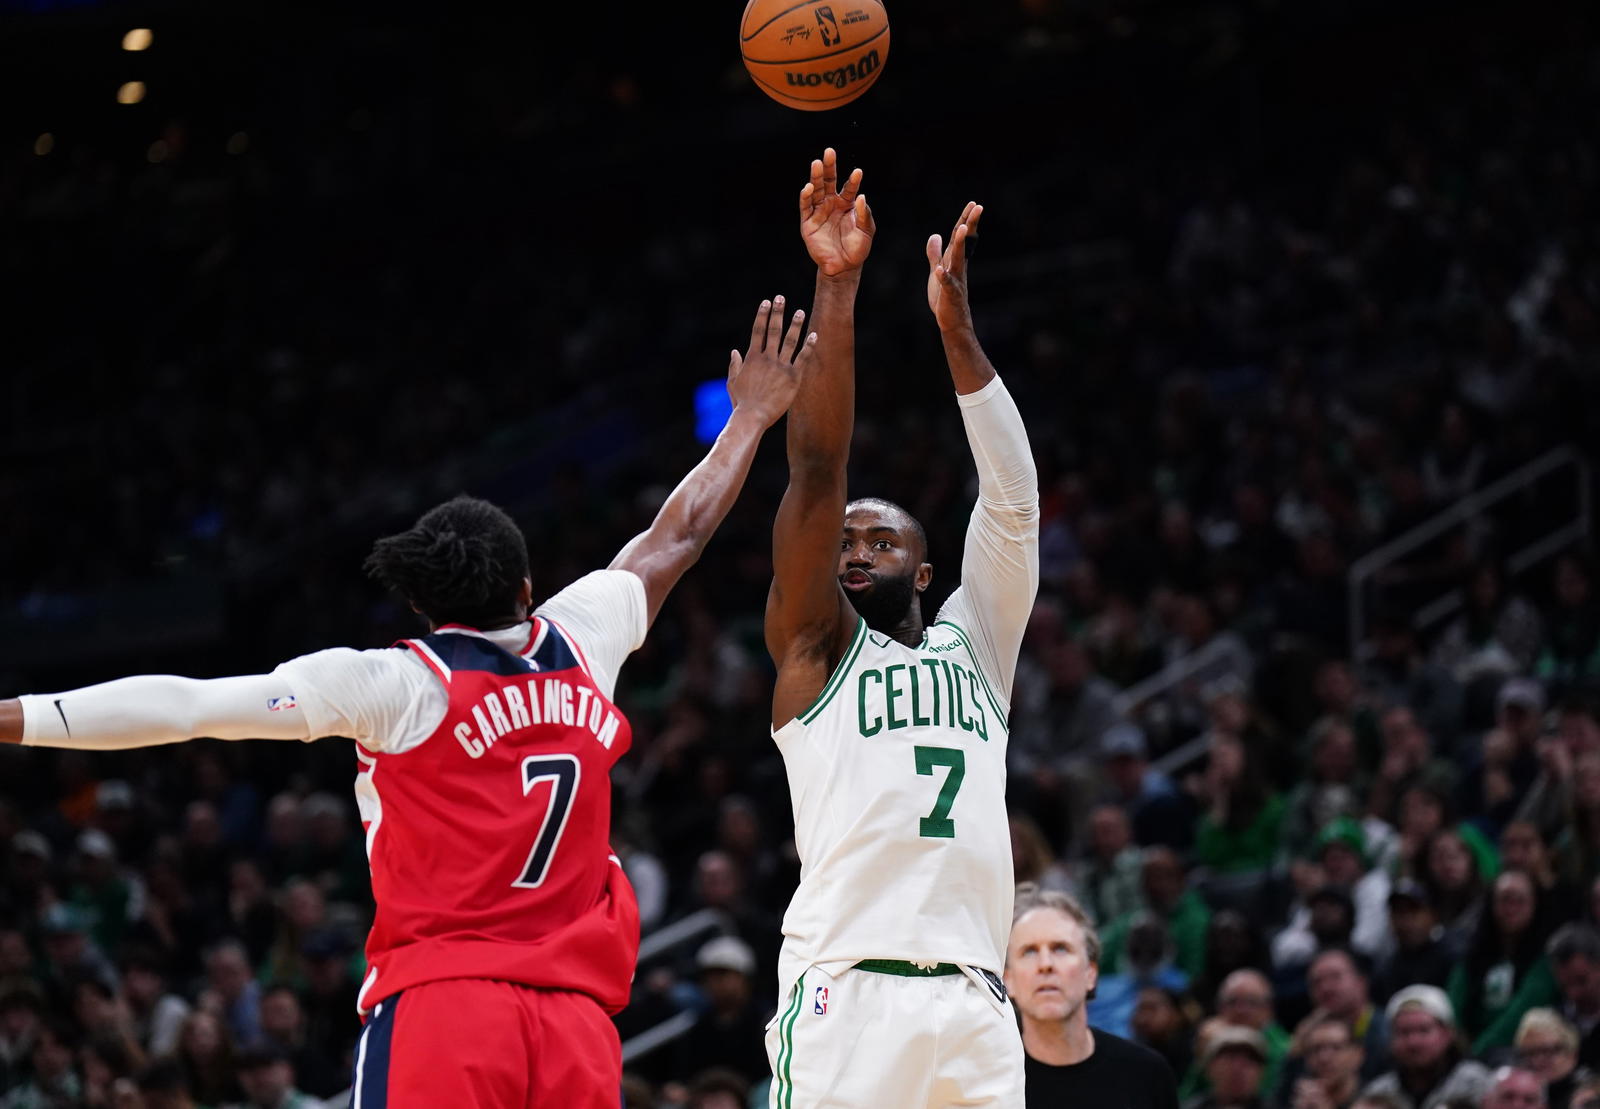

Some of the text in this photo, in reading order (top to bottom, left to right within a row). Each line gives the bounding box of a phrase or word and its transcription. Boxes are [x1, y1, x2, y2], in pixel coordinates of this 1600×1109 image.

[784, 49, 880, 89] Wilson
[453, 678, 620, 759] CARRINGTON
[858, 658, 989, 742] CELTICS
[510, 753, 581, 889] 7
[914, 745, 965, 838] 7
